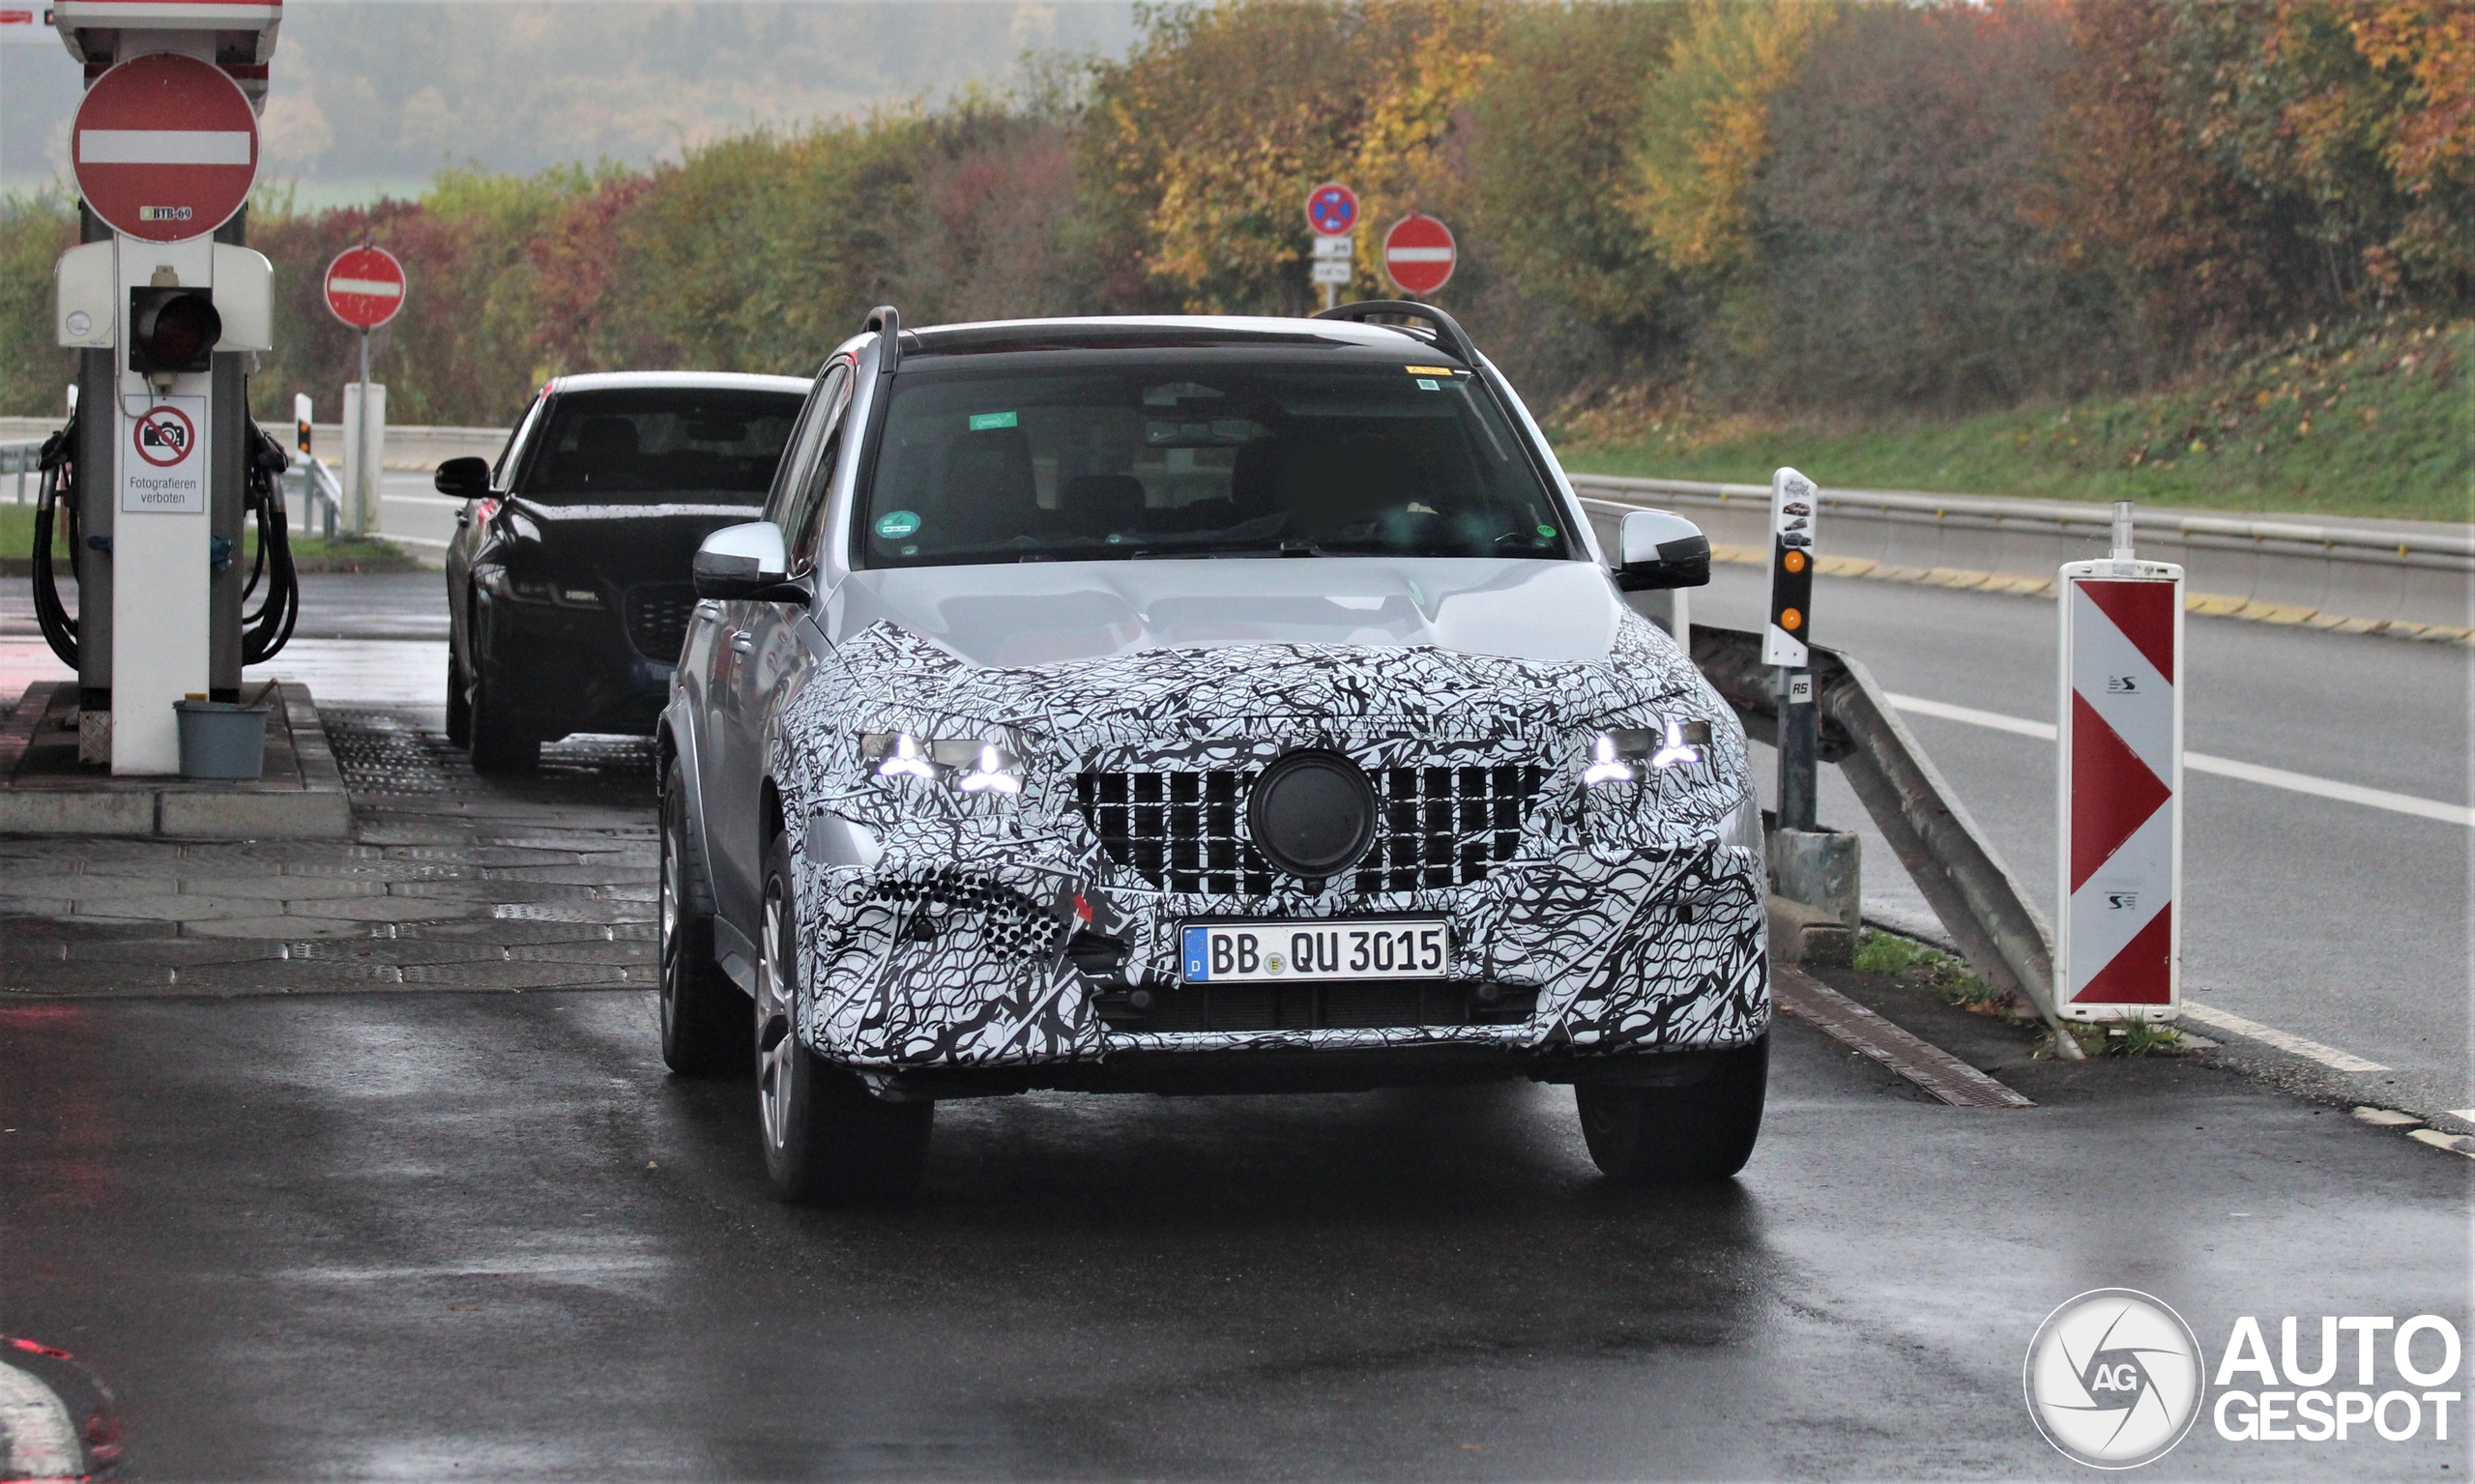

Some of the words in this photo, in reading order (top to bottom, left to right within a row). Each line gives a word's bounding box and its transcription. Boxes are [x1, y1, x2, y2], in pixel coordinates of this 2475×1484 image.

[153, 207, 191, 219] BTB-69
[130, 477, 196, 490] Fotografieren
[141, 492, 186, 504] verboten
[1212, 934, 1260, 975] BB
[1292, 932, 1338, 973] QU
[1349, 930, 1441, 972] 3015
[1191, 960, 1201, 973] D
